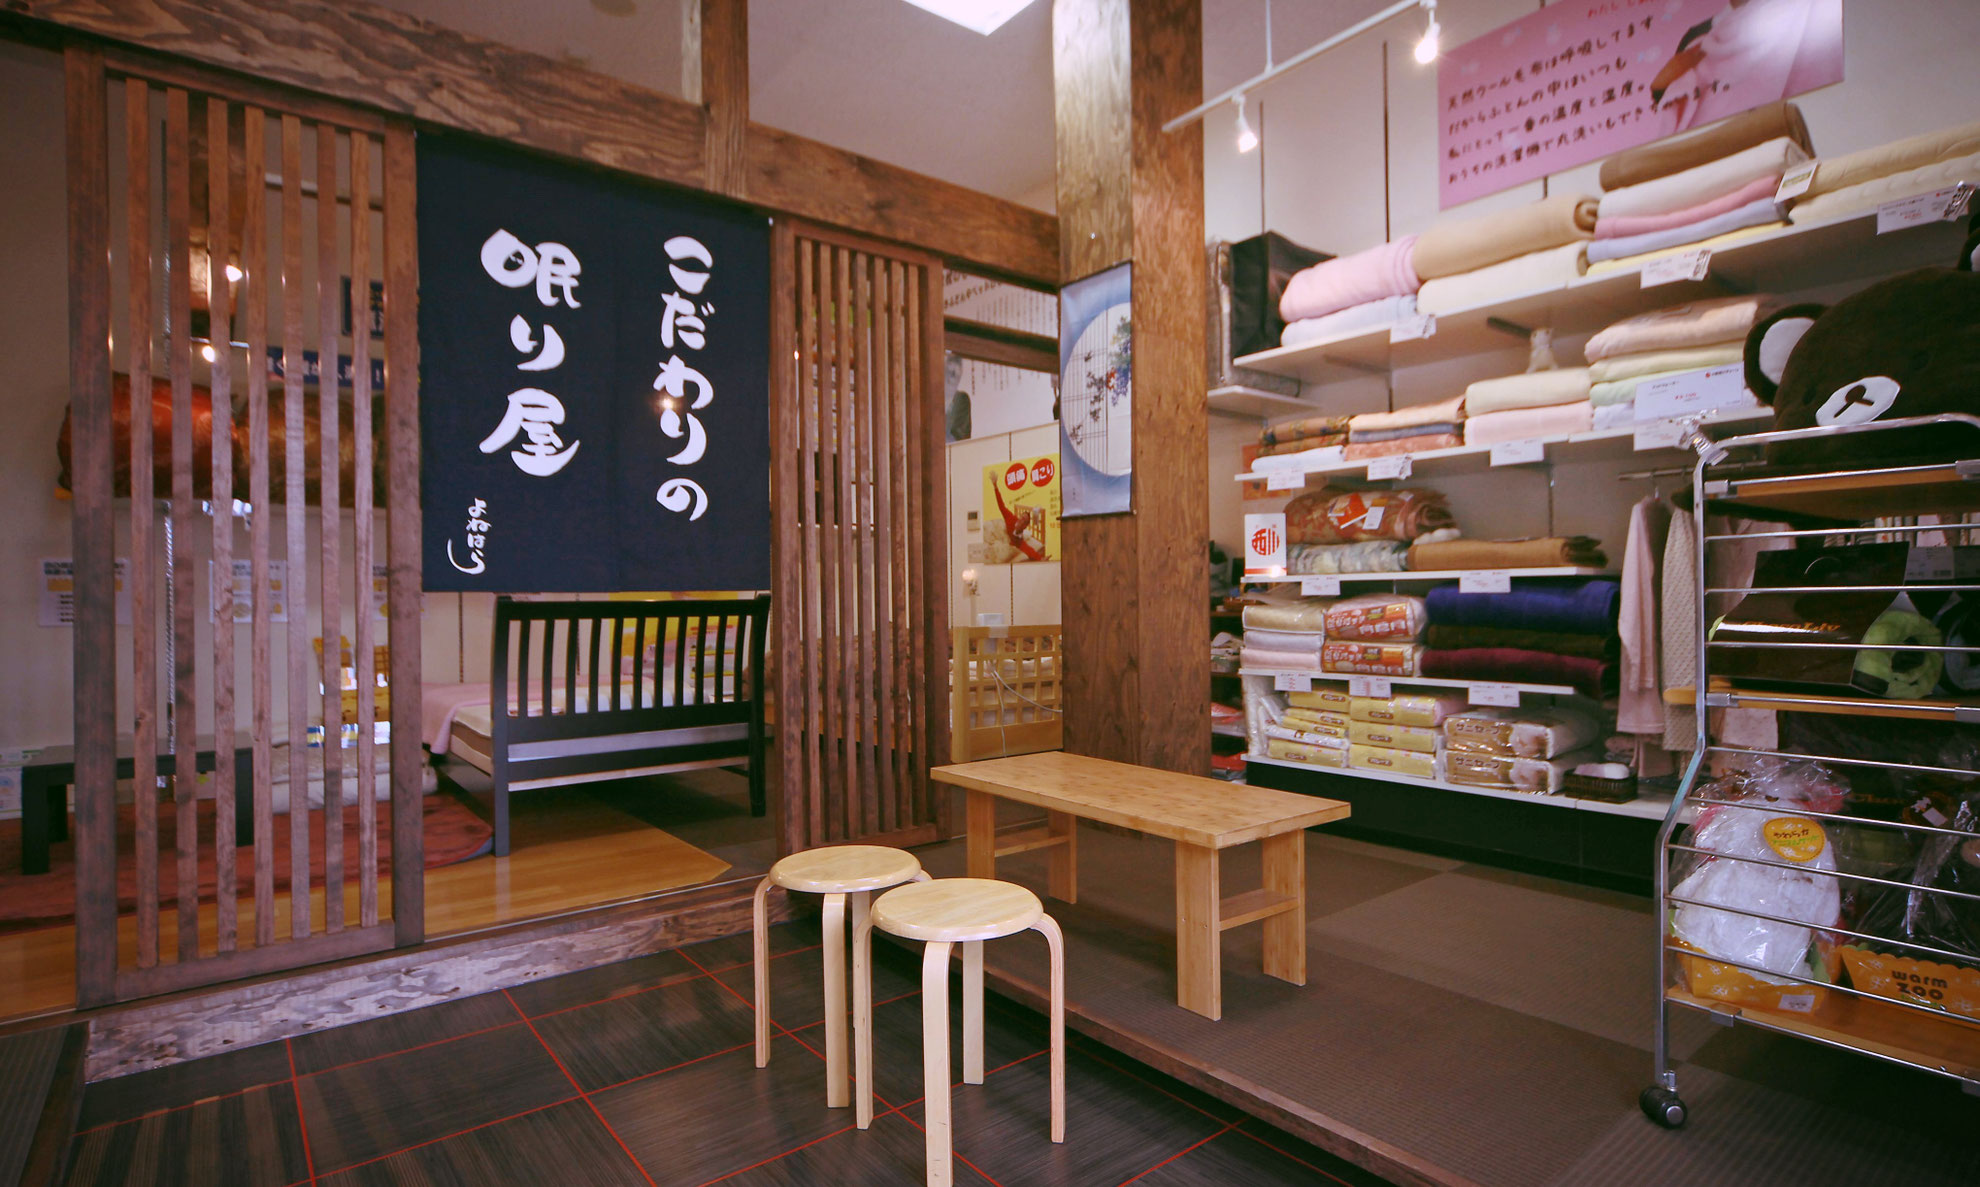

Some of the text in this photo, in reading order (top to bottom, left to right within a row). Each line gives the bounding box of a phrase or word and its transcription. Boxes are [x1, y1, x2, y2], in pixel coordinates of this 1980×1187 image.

[479, 228, 582, 477] 眠り屋
[652, 235, 715, 522] こだわりの
[1891, 970, 1948, 988] warm
